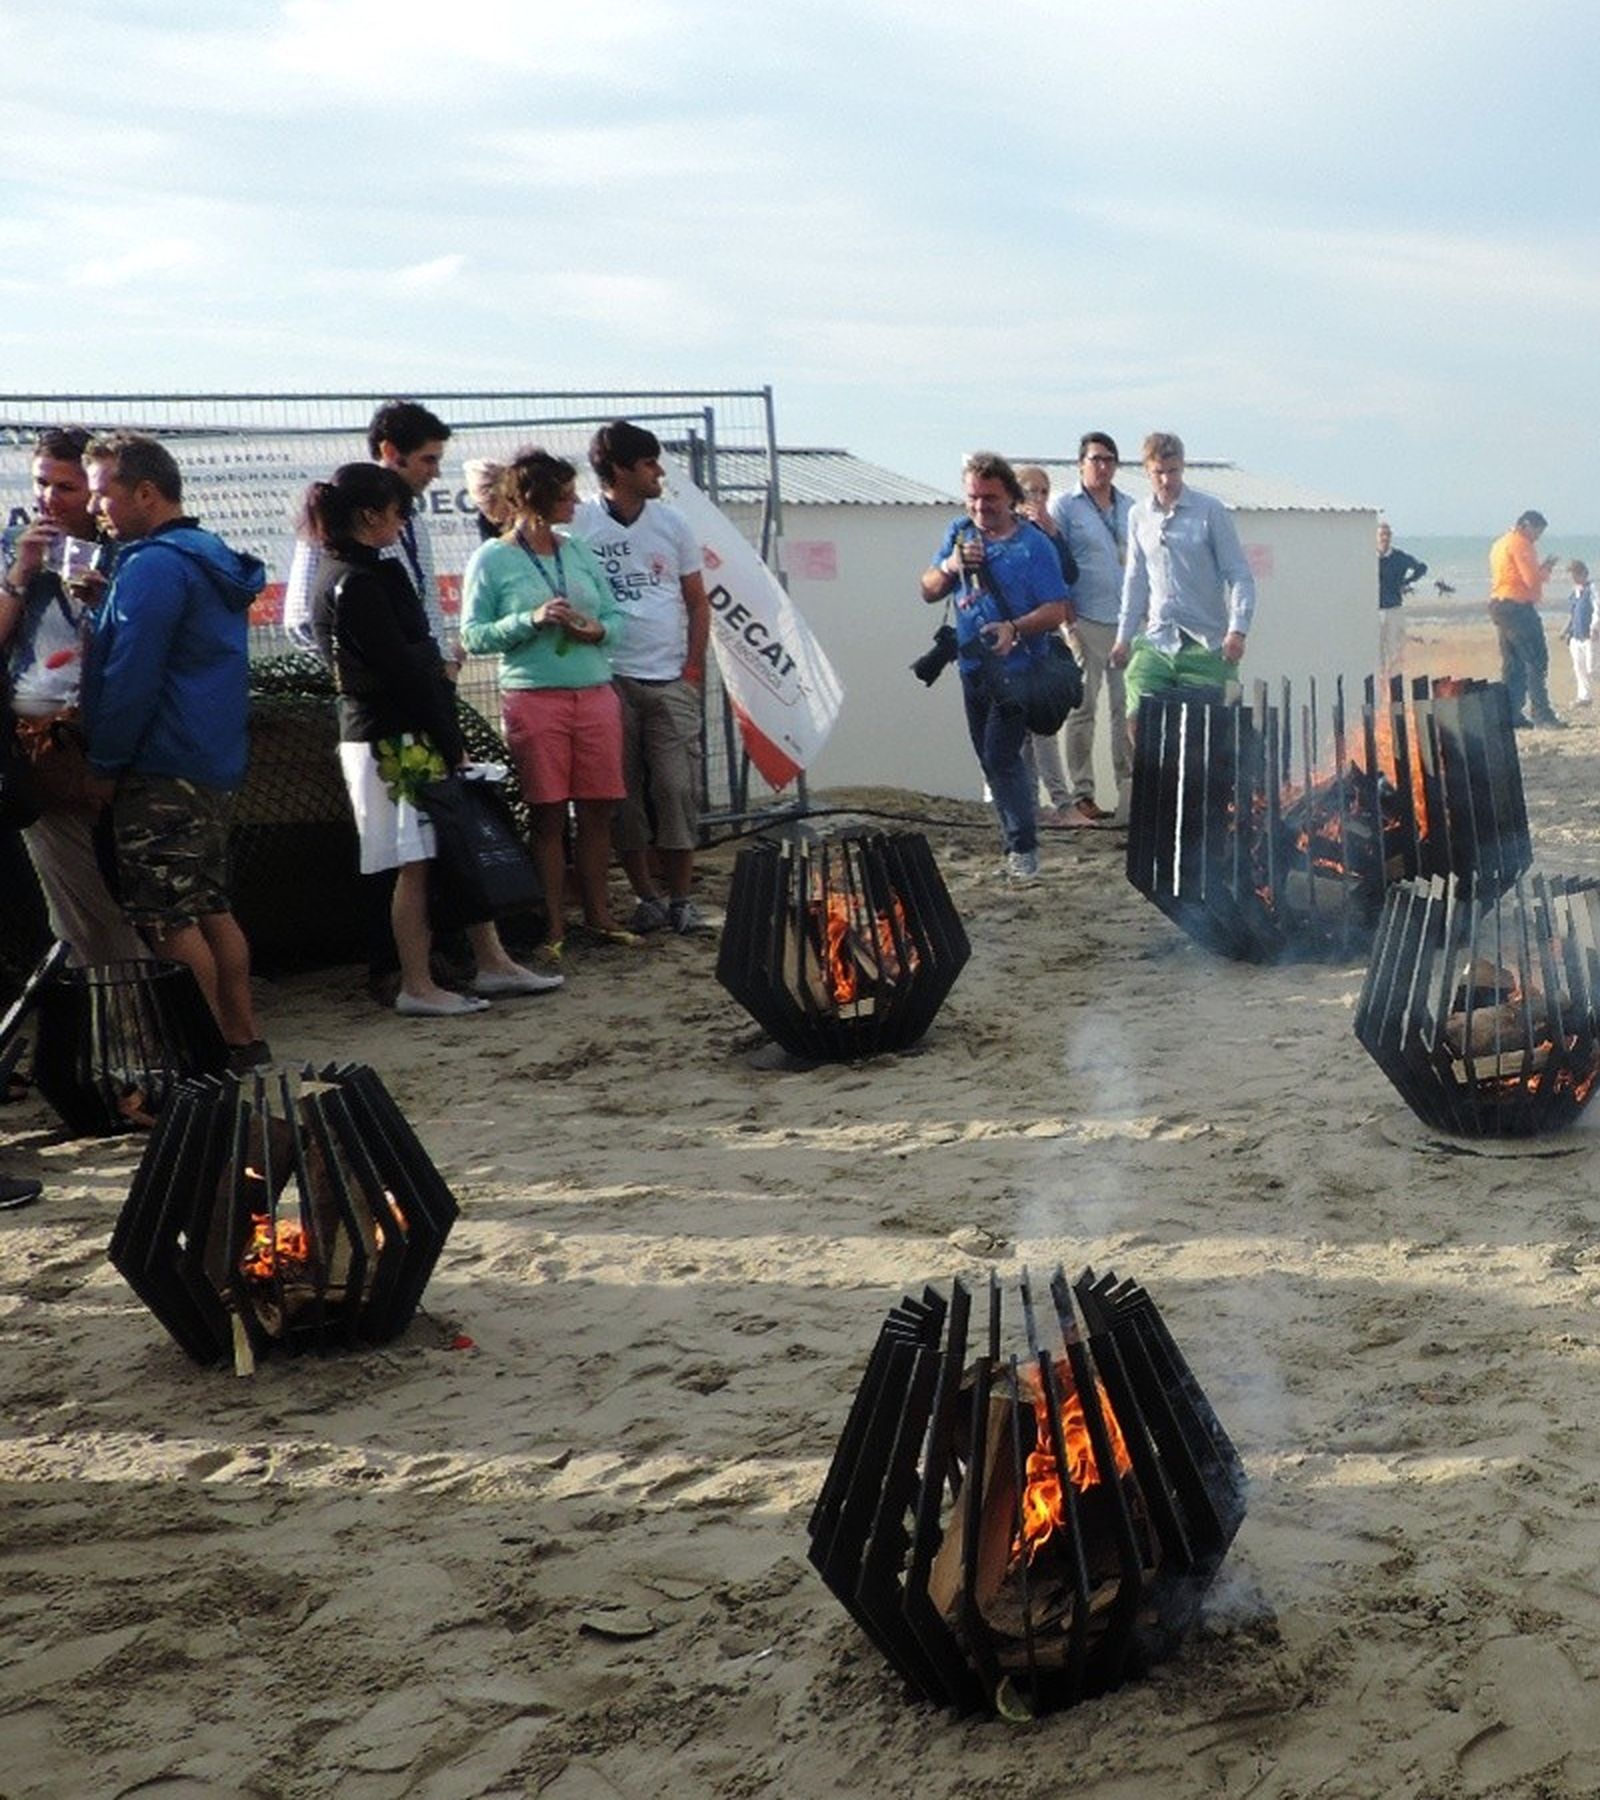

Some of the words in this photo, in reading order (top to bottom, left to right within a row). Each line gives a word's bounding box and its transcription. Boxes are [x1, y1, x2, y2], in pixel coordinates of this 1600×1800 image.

[599, 559, 620, 574] O
[607, 572, 661, 588] EED
[613, 589, 642, 602] OU
[707, 584, 797, 677] DECAT
